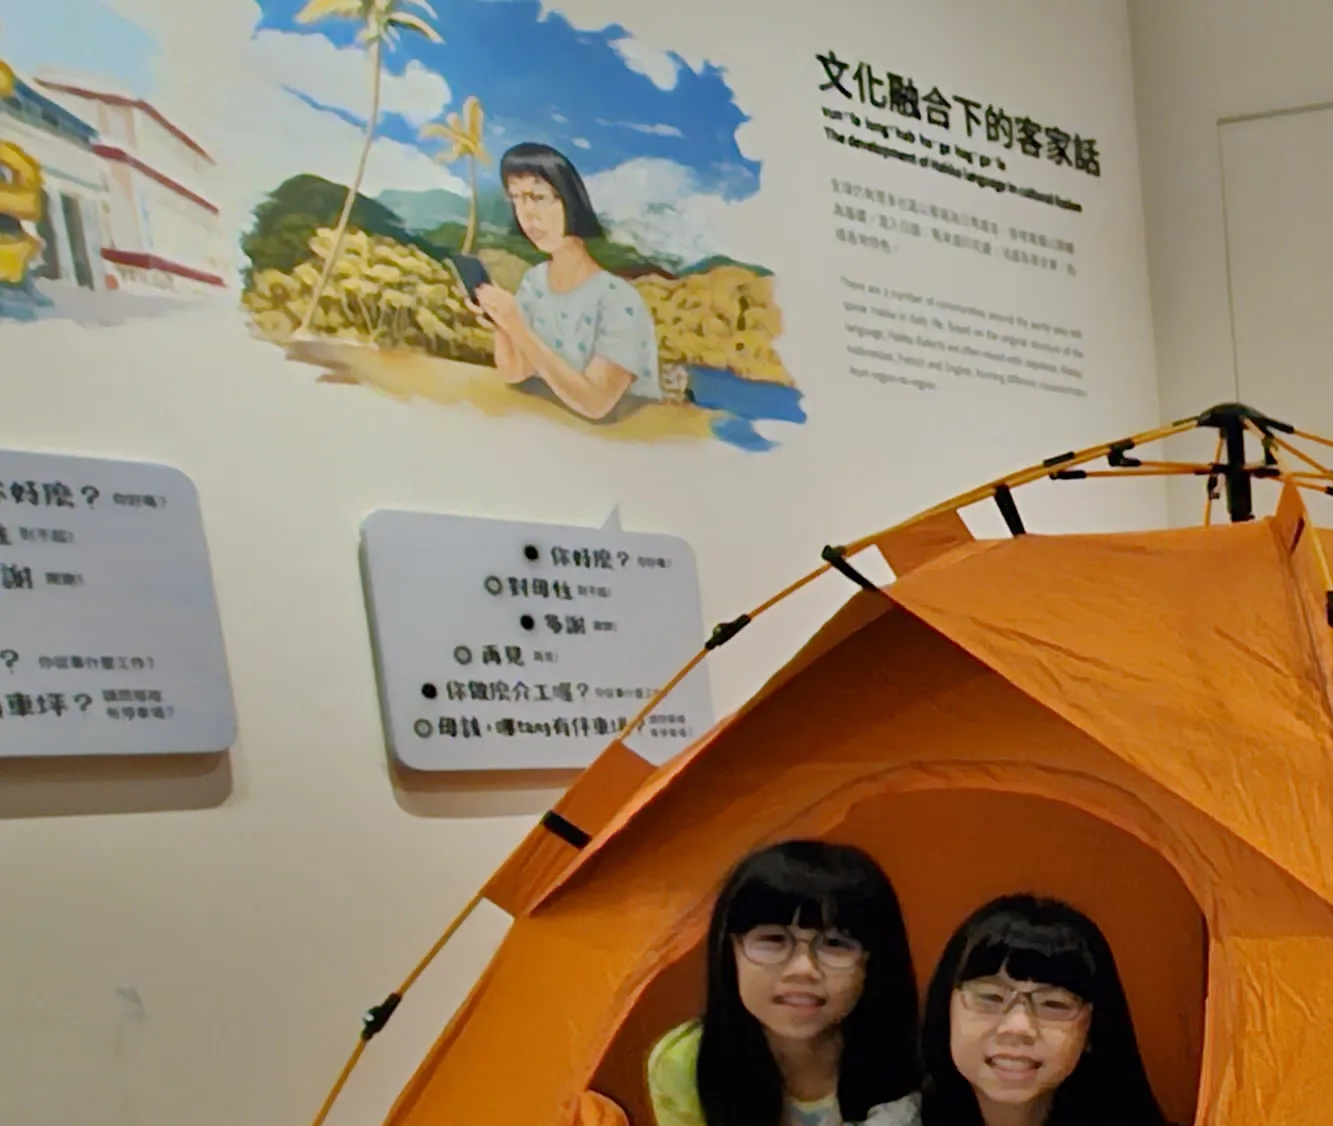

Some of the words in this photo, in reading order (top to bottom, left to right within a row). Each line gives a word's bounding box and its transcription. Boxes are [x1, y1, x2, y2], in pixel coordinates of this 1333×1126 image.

[815, 49, 1102, 178] 文化融合下的客家話
[481, 644, 525, 666] 再見
